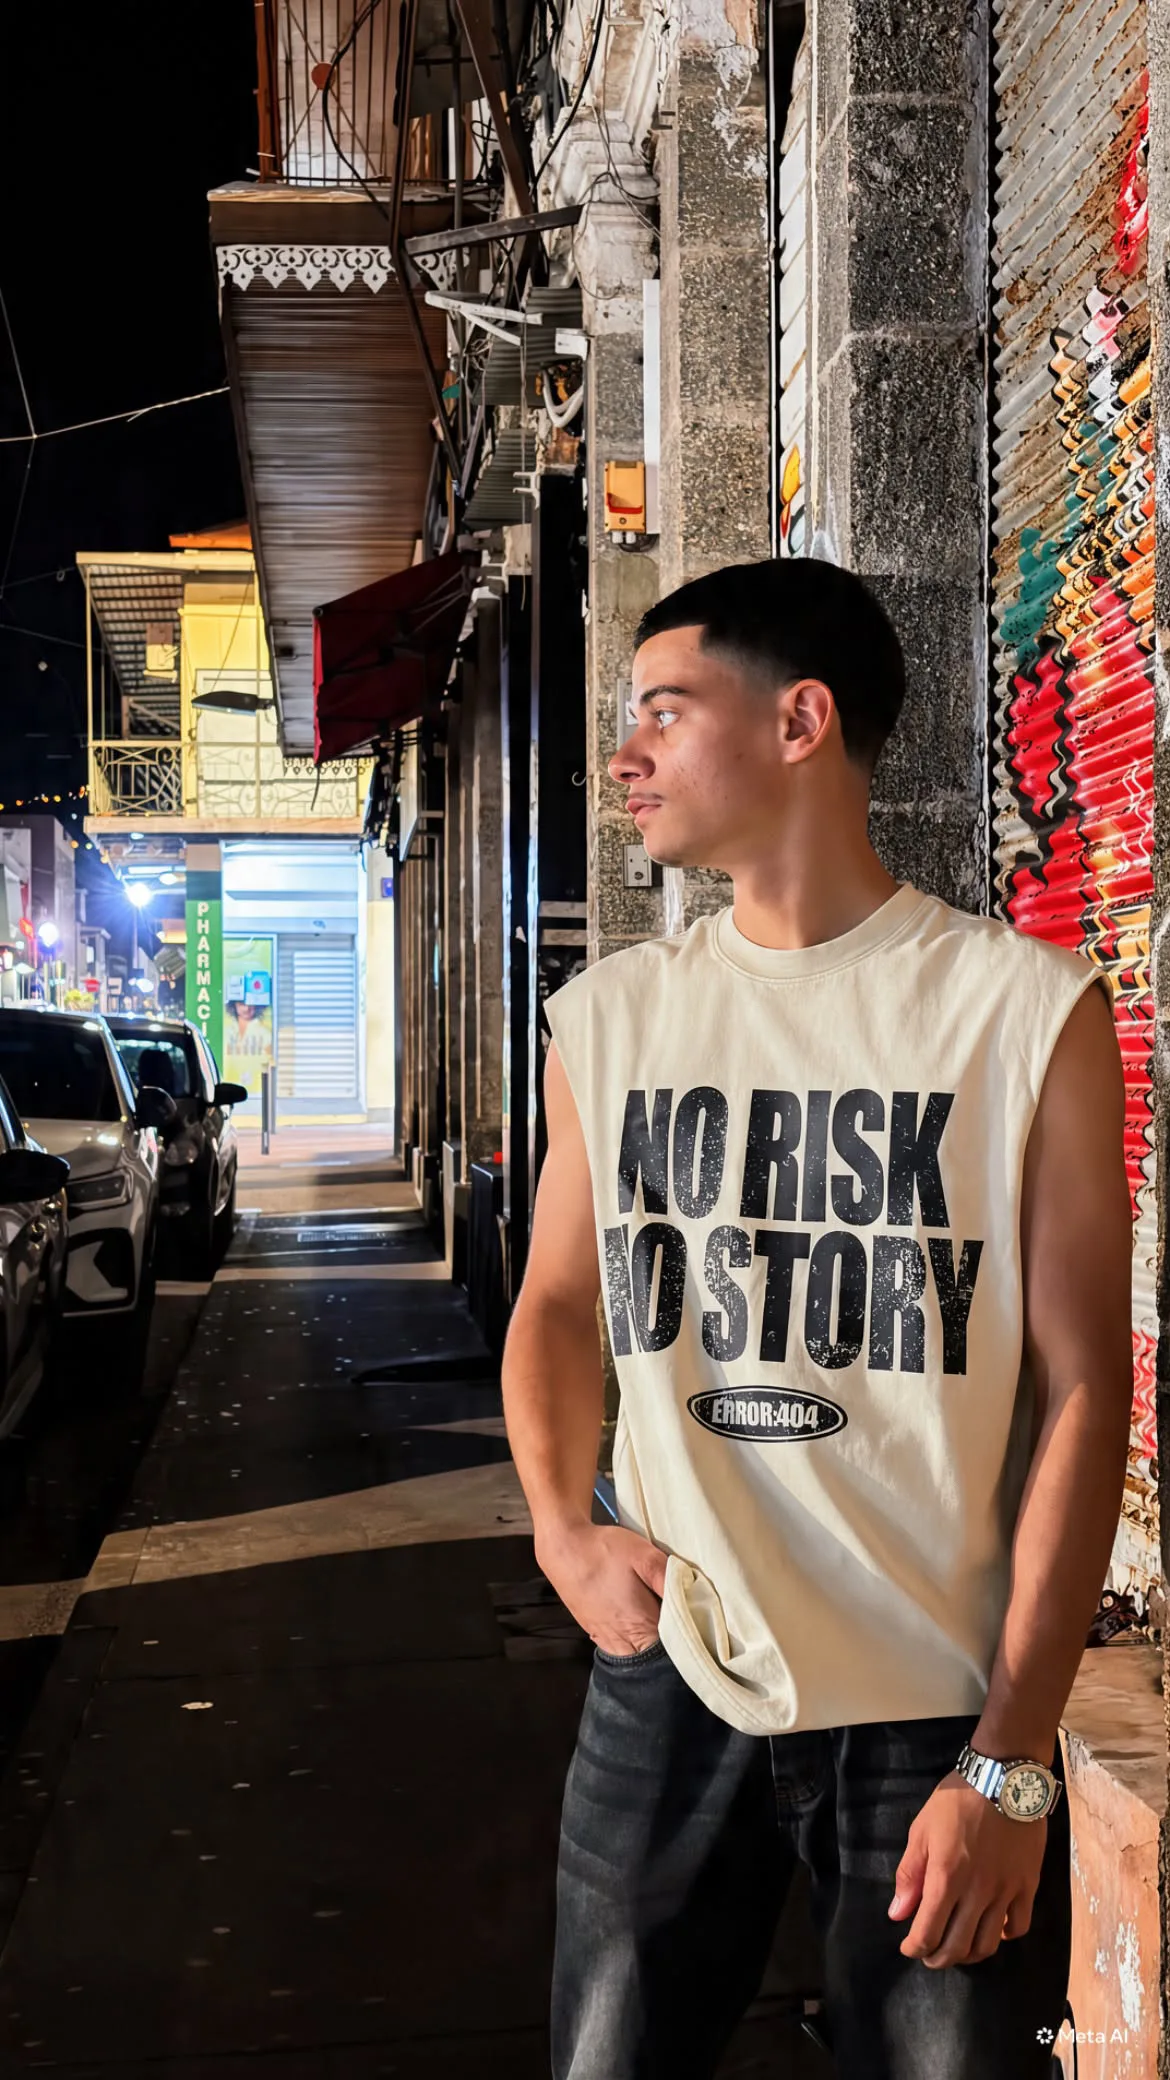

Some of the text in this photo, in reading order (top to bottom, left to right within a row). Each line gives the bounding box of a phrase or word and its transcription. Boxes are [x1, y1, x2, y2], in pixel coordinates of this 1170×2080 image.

[196, 902, 211, 1044] PHARMACI
[617, 1086, 955, 1228] NO RISK
[702, 1225, 984, 1375] STORY
